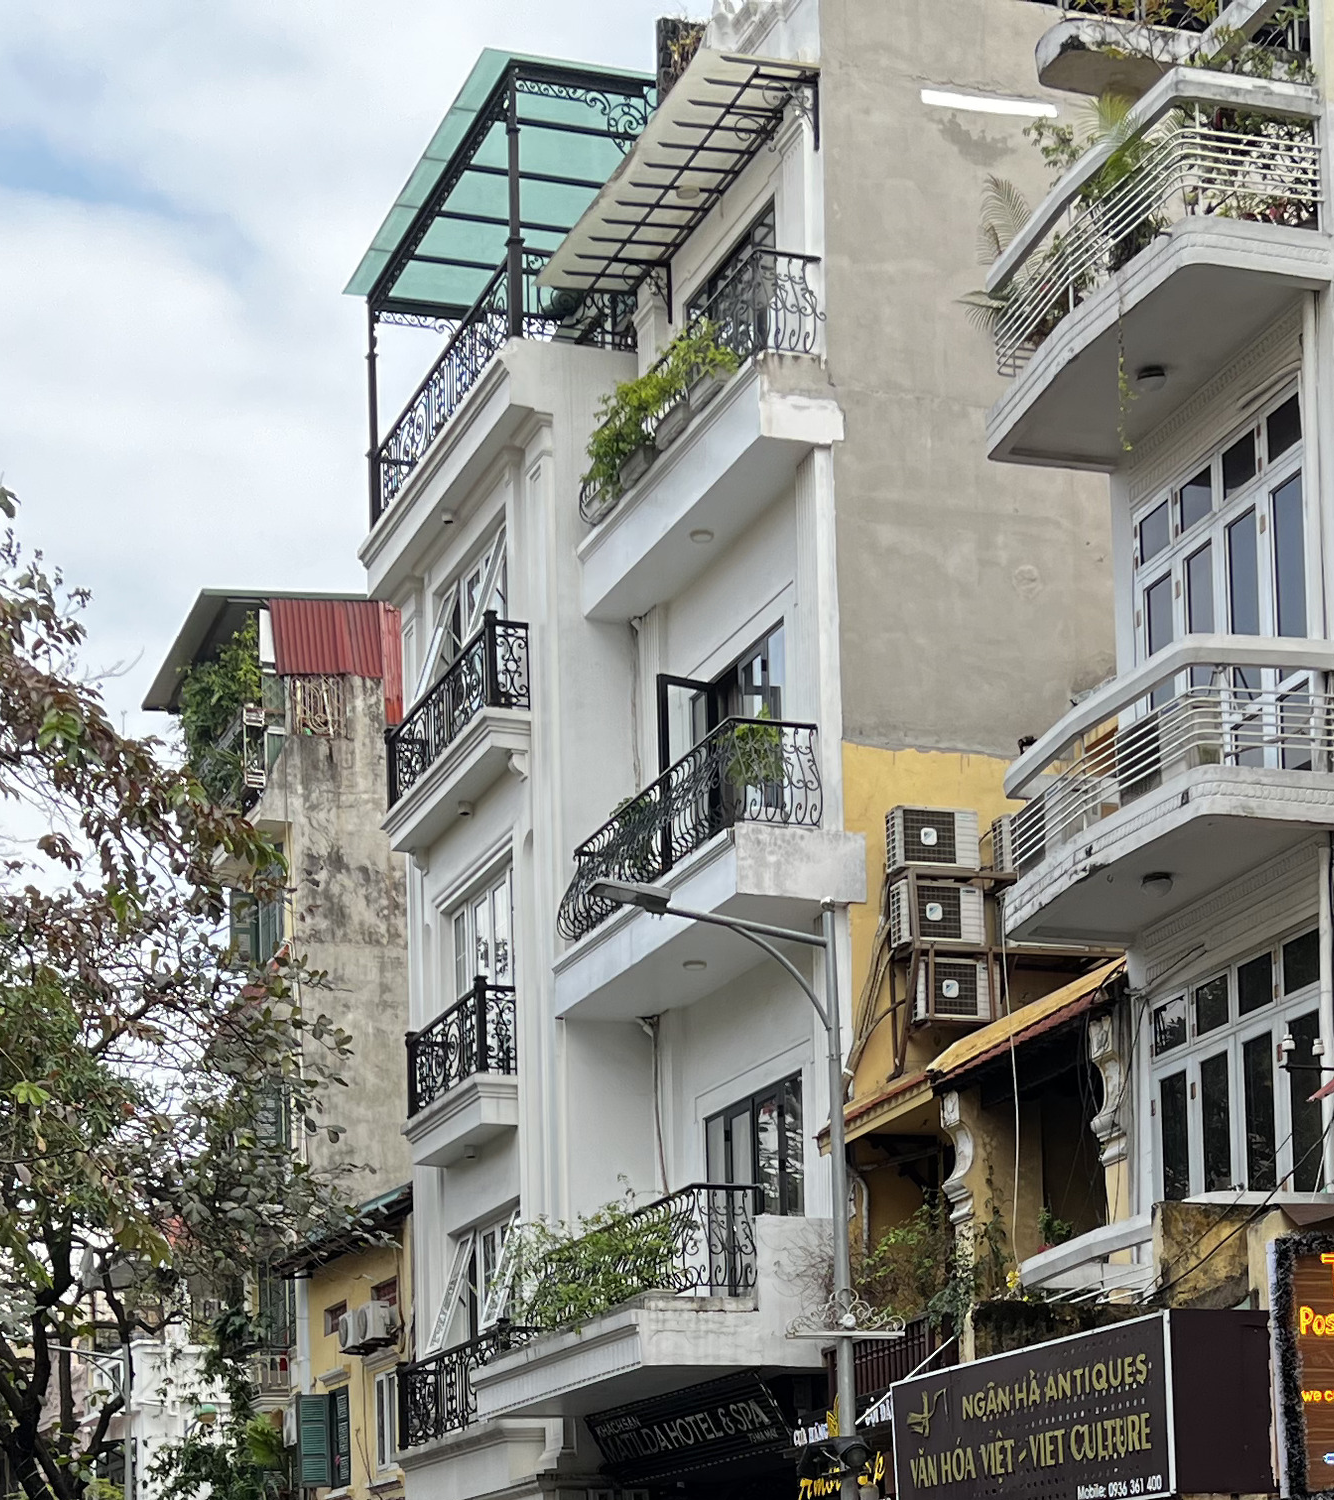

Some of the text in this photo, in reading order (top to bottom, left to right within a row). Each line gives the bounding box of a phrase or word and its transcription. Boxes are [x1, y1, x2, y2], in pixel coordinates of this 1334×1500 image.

[962, 1353, 1149, 1420] NGÂN HÀ ANTIQUES
[1301, 1389, 1322, 1403] we
[602, 1398, 772, 1465] MATILDA HOTEL & SPA
[910, 1448, 938, 1488] VĂN
[941, 1437, 977, 1483] HÓA
[980, 1431, 1015, 1485] VIỆT
[1029, 1428, 1066, 1470] VIET
[1070, 1412, 1152, 1462] CULTURE
[1077, 1474, 1162, 1500] Mobile: 0936 361 400
